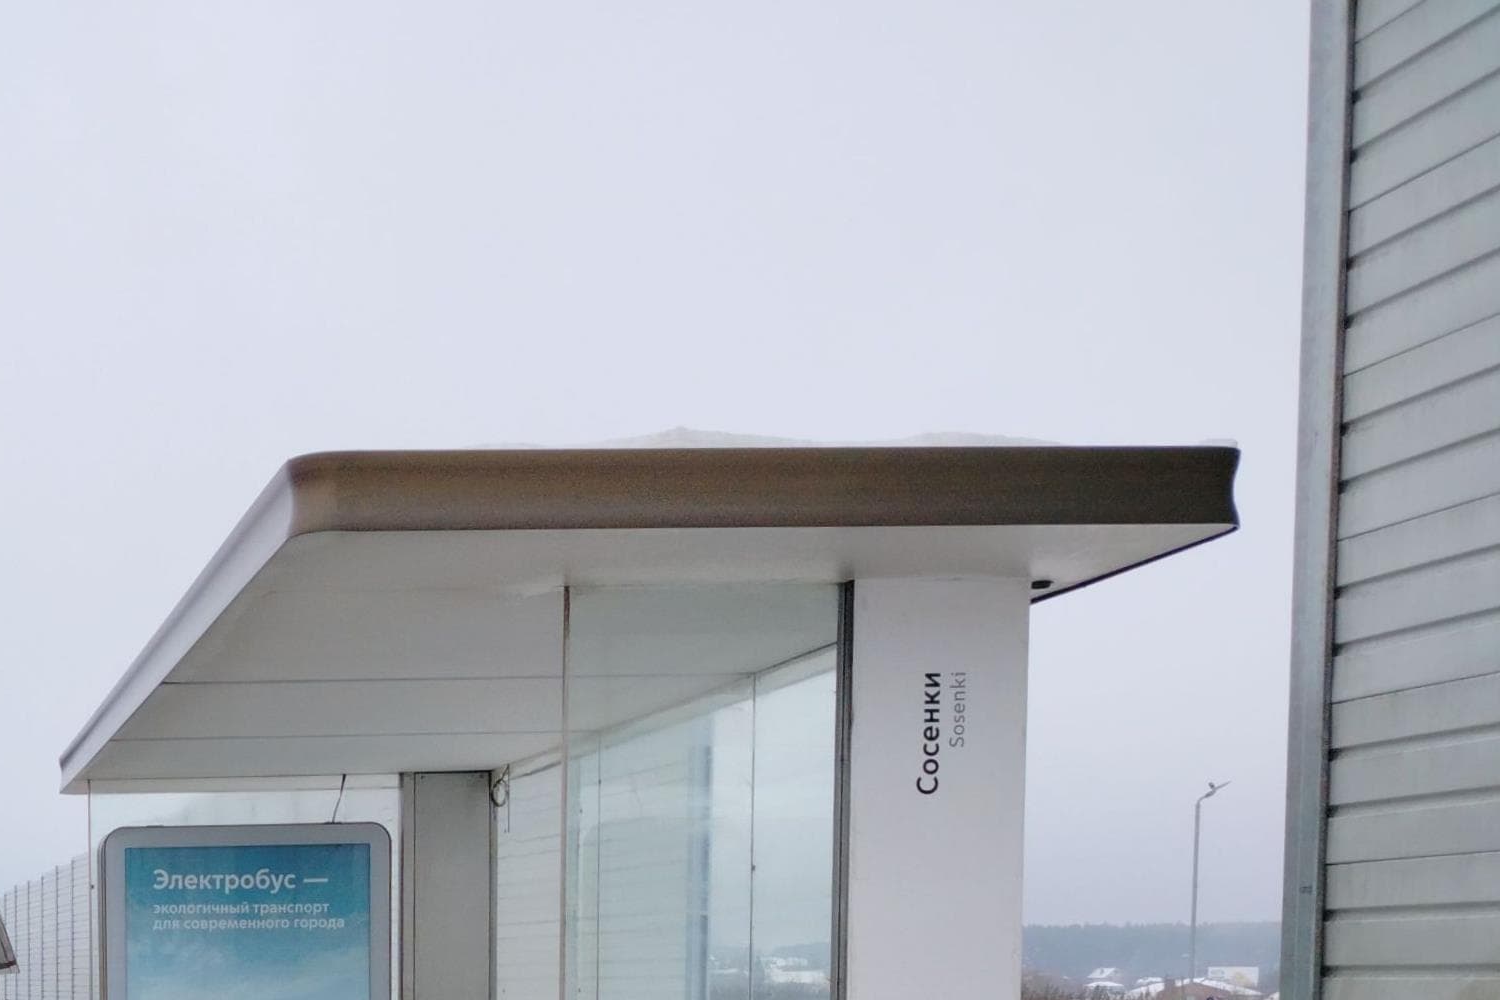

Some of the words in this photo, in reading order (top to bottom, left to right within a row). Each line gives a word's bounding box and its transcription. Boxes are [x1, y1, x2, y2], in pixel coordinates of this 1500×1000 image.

[948, 672, 966, 748] Sosenki
[916, 672, 941, 795] Сосенки
[153, 868, 296, 894] Электробус
[153, 901, 250, 915] экологичный
[253, 902, 330, 916] транспорт
[153, 918, 181, 931] для
[184, 917, 290, 932] современного
[294, 916, 345, 931] города
